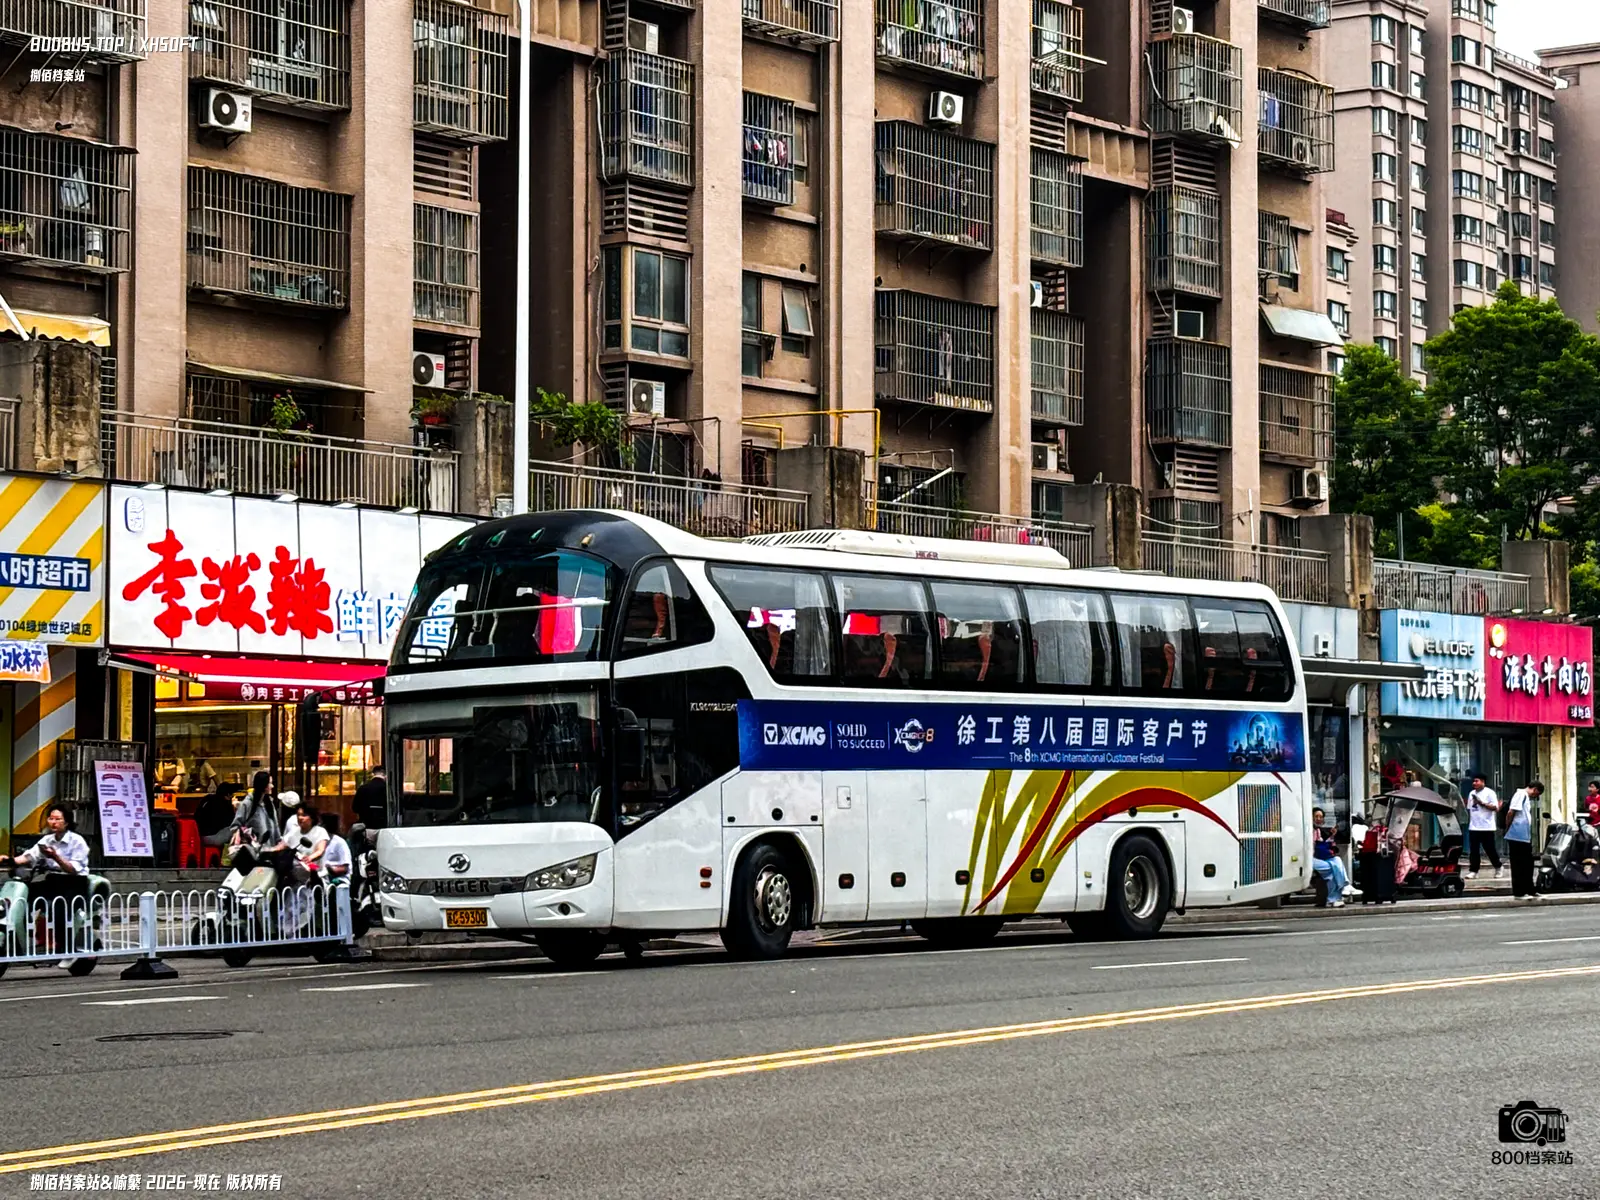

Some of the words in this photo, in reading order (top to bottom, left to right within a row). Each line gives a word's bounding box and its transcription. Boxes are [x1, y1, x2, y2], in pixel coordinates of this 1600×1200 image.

[0, 557, 89, 588] 时超市
[0, 646, 43, 673] 冰杯
[779, 726, 826, 746] XCMG
[836, 723, 867, 737] SOLID
[957, 714, 1208, 748] 徐工第八届国际客户节
[838, 740, 849, 749] TO
[850, 739, 886, 749] SUCCEED
[1009, 752, 1023, 763] The
[1024, 747, 1039, 763] 8th
[1040, 752, 1061, 763] XCMG
[1062, 752, 1105, 763] International
[1106, 753, 1138, 764] Customer
[1140, 753, 1165, 764] Festival
[434, 880, 490, 894] HIGER
